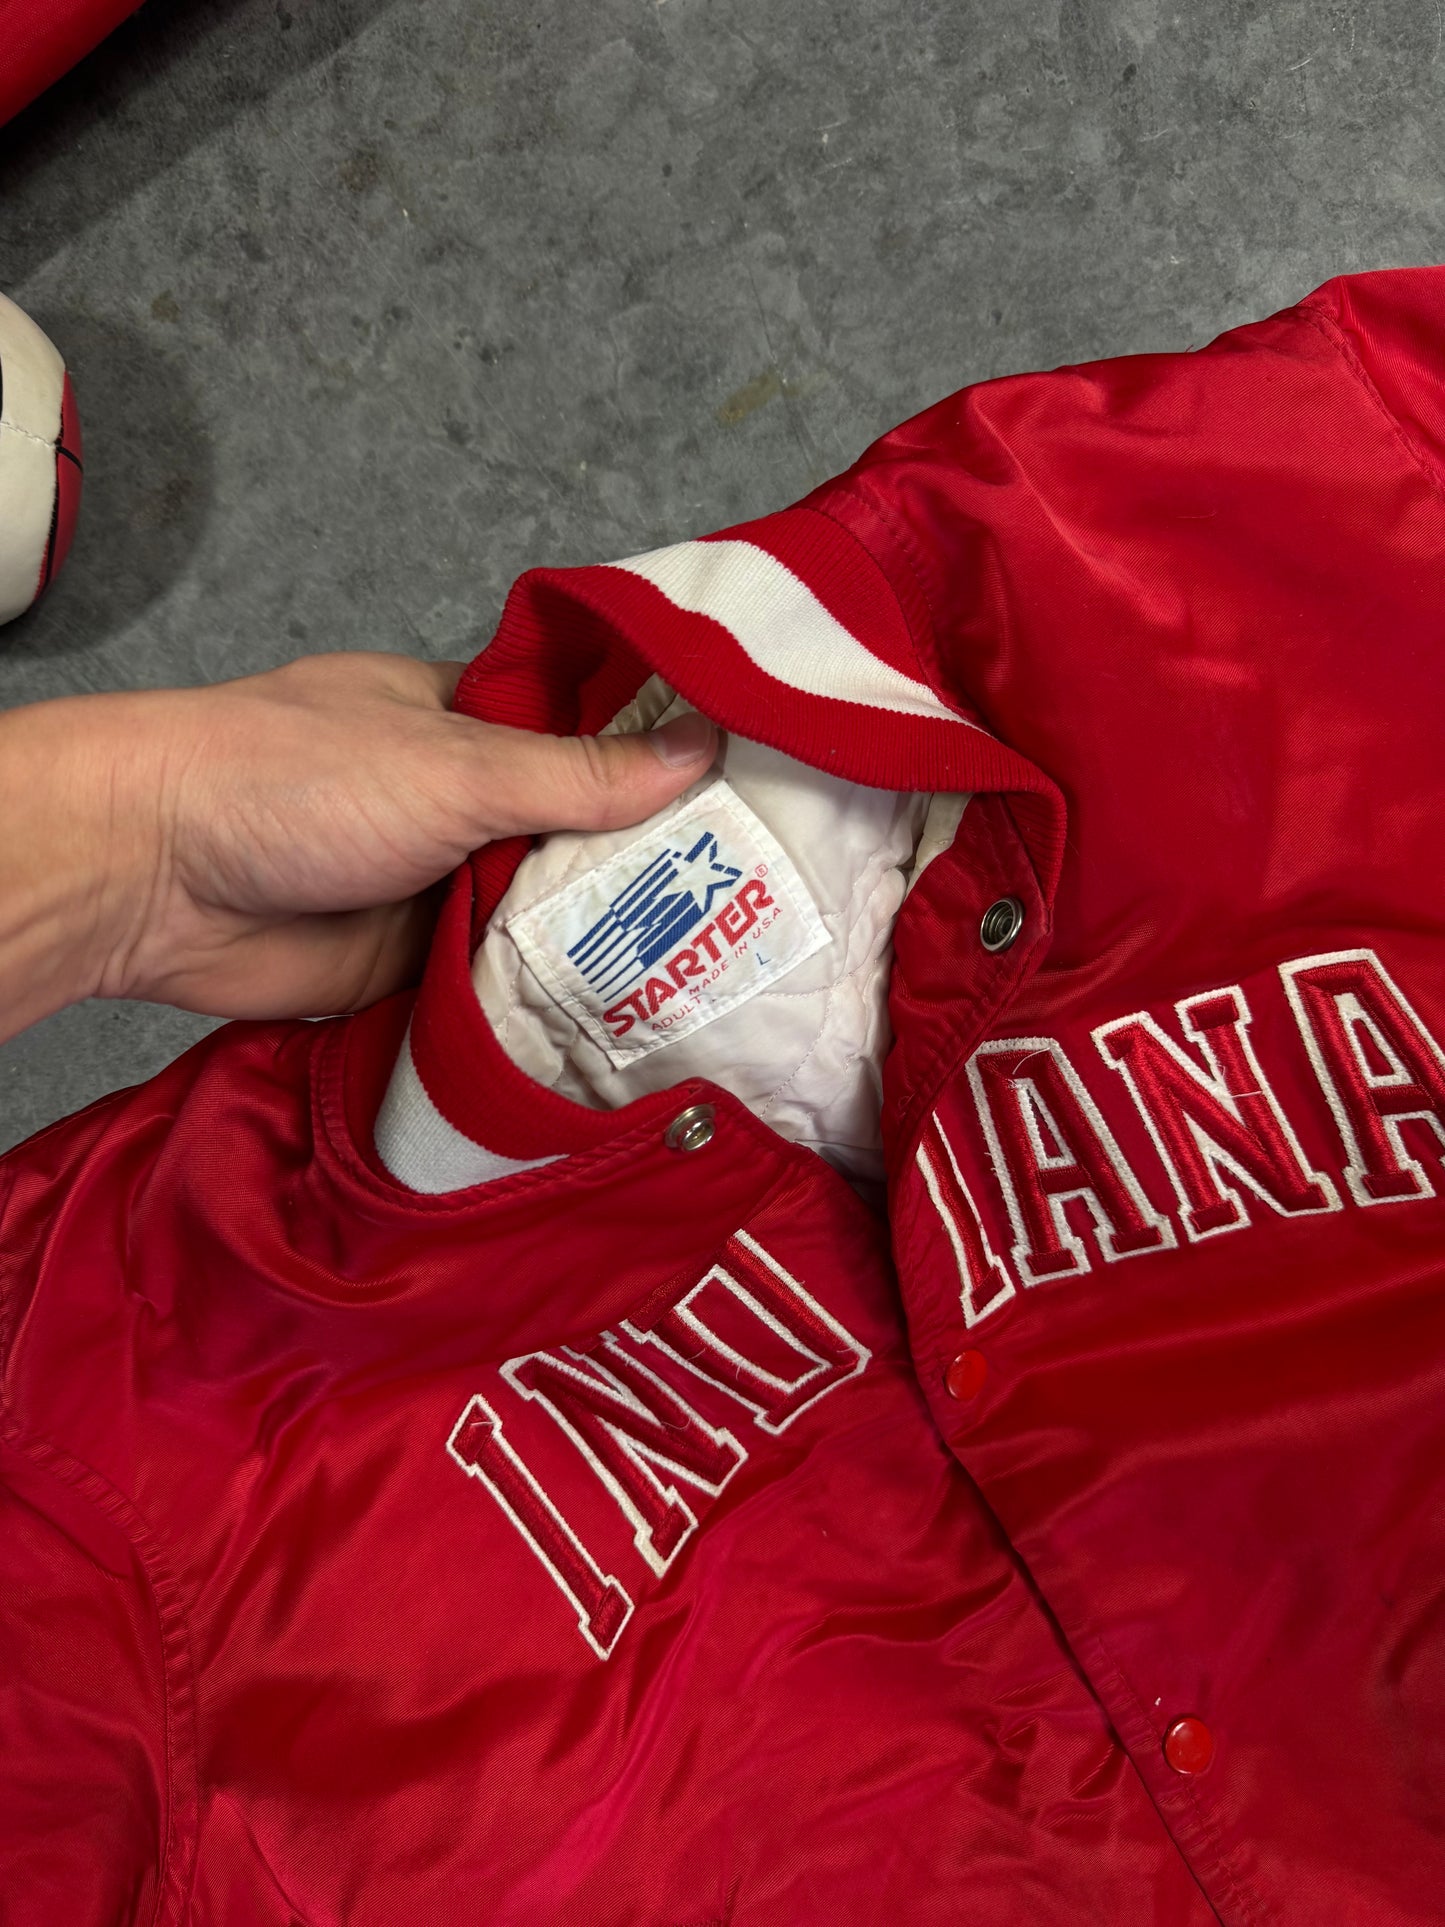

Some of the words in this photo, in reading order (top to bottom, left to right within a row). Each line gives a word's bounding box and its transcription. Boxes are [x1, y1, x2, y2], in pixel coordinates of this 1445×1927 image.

[651, 995, 703, 1032] ADULT
[756, 952, 771, 966] L
[689, 962, 729, 995] MADE
[735, 943, 749, 960] IN
